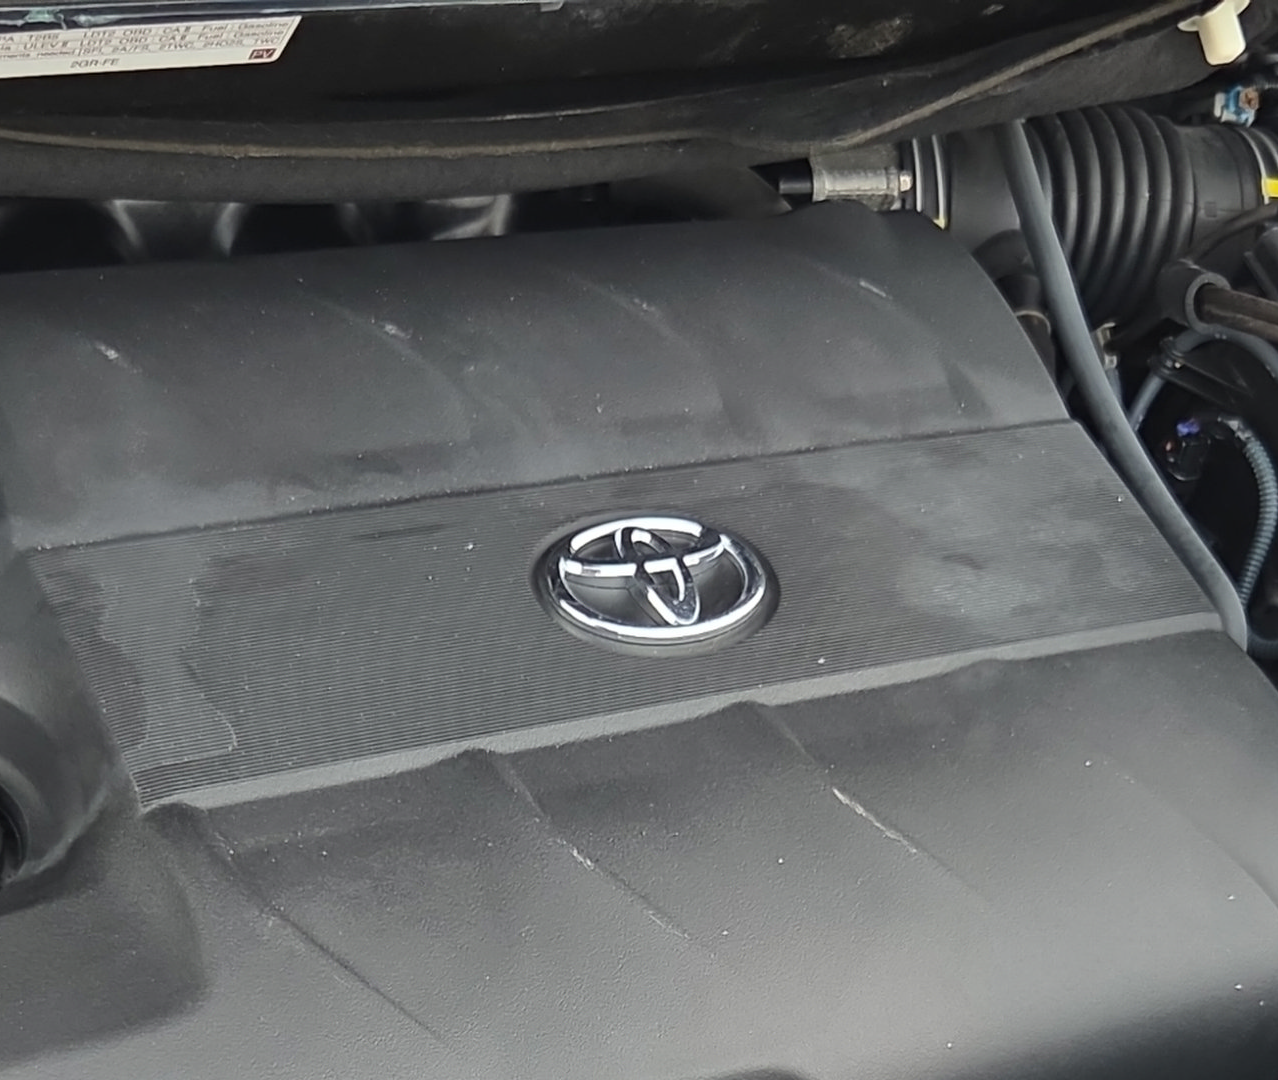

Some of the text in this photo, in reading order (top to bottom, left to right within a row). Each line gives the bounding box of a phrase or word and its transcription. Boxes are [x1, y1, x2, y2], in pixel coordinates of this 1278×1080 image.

[238, 21, 289, 30] Gasoline
[233, 30, 285, 38] Gasoline
[37, 49, 76, 58] needed
[251, 49, 275, 59] PV
